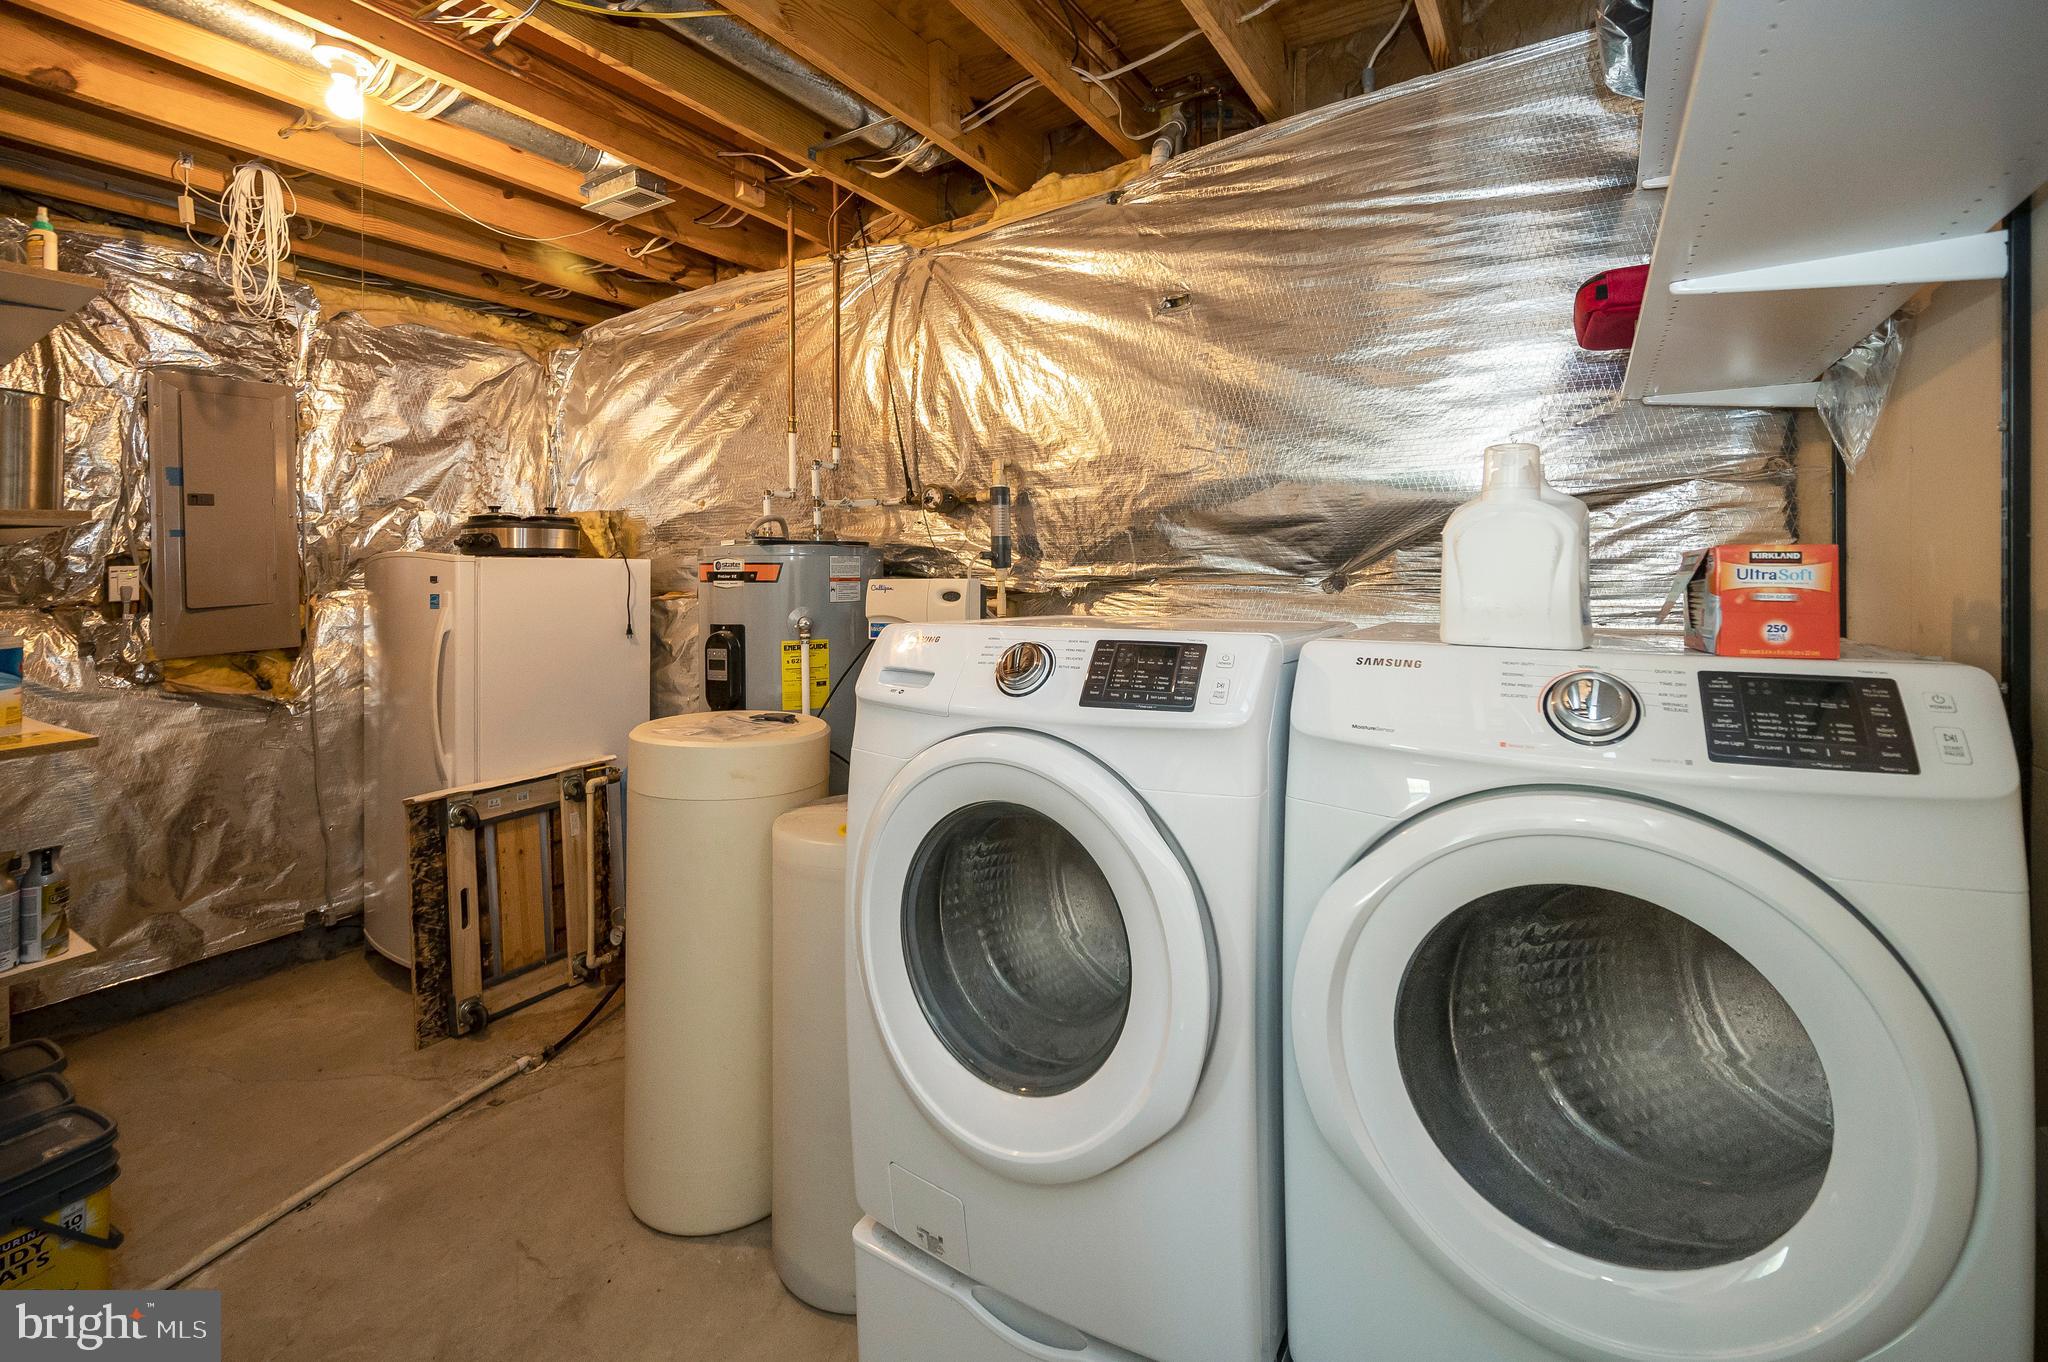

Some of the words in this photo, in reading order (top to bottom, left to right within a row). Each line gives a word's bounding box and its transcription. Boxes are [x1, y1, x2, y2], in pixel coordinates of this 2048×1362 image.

[870, 584, 894, 593] Culligan
[1766, 624, 1788, 633] 250
[1356, 656, 1422, 668] SAMSUNG
[64, 1214, 82, 1230] 10
[2, 1230, 40, 1252] URIN
